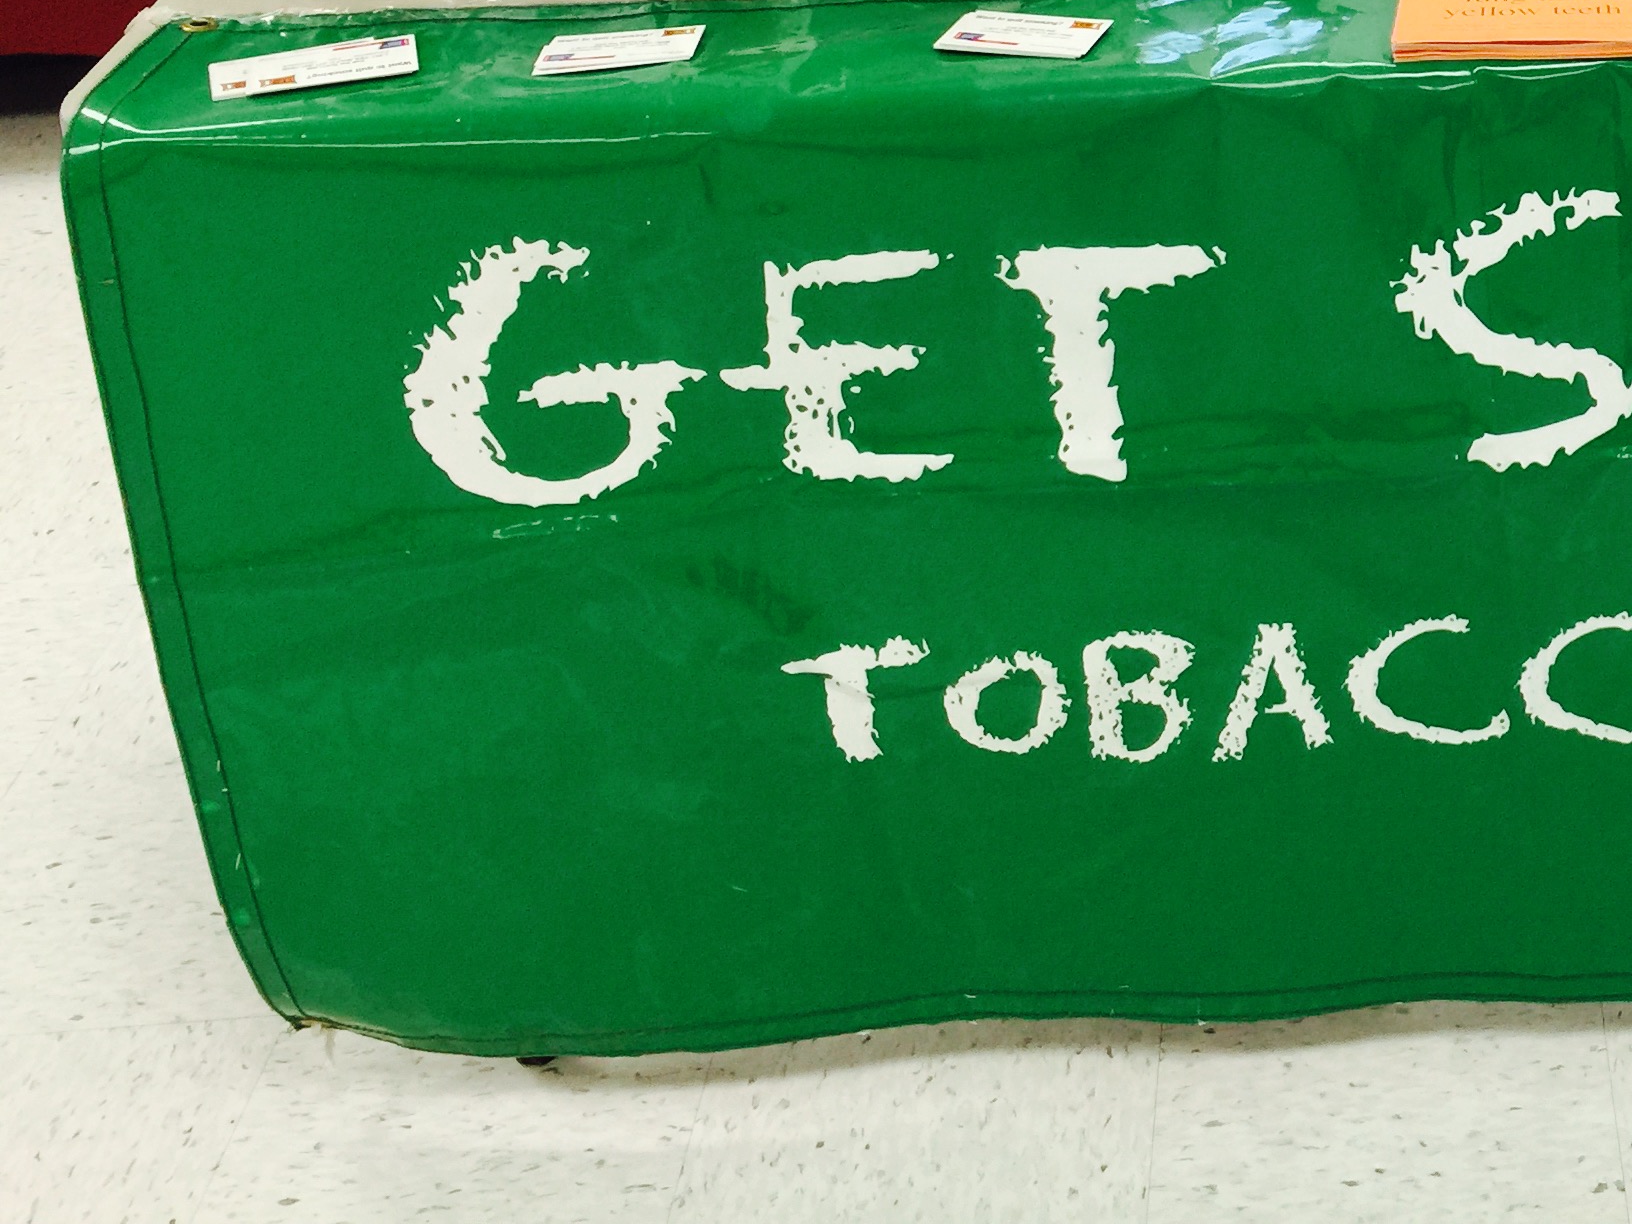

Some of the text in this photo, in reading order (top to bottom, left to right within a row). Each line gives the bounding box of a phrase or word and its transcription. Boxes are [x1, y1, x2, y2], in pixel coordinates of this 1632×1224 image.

[1443, 6, 1540, 20] yellow
[1552, 3, 1622, 16] teeth
[402, 235, 1226, 507] GET
